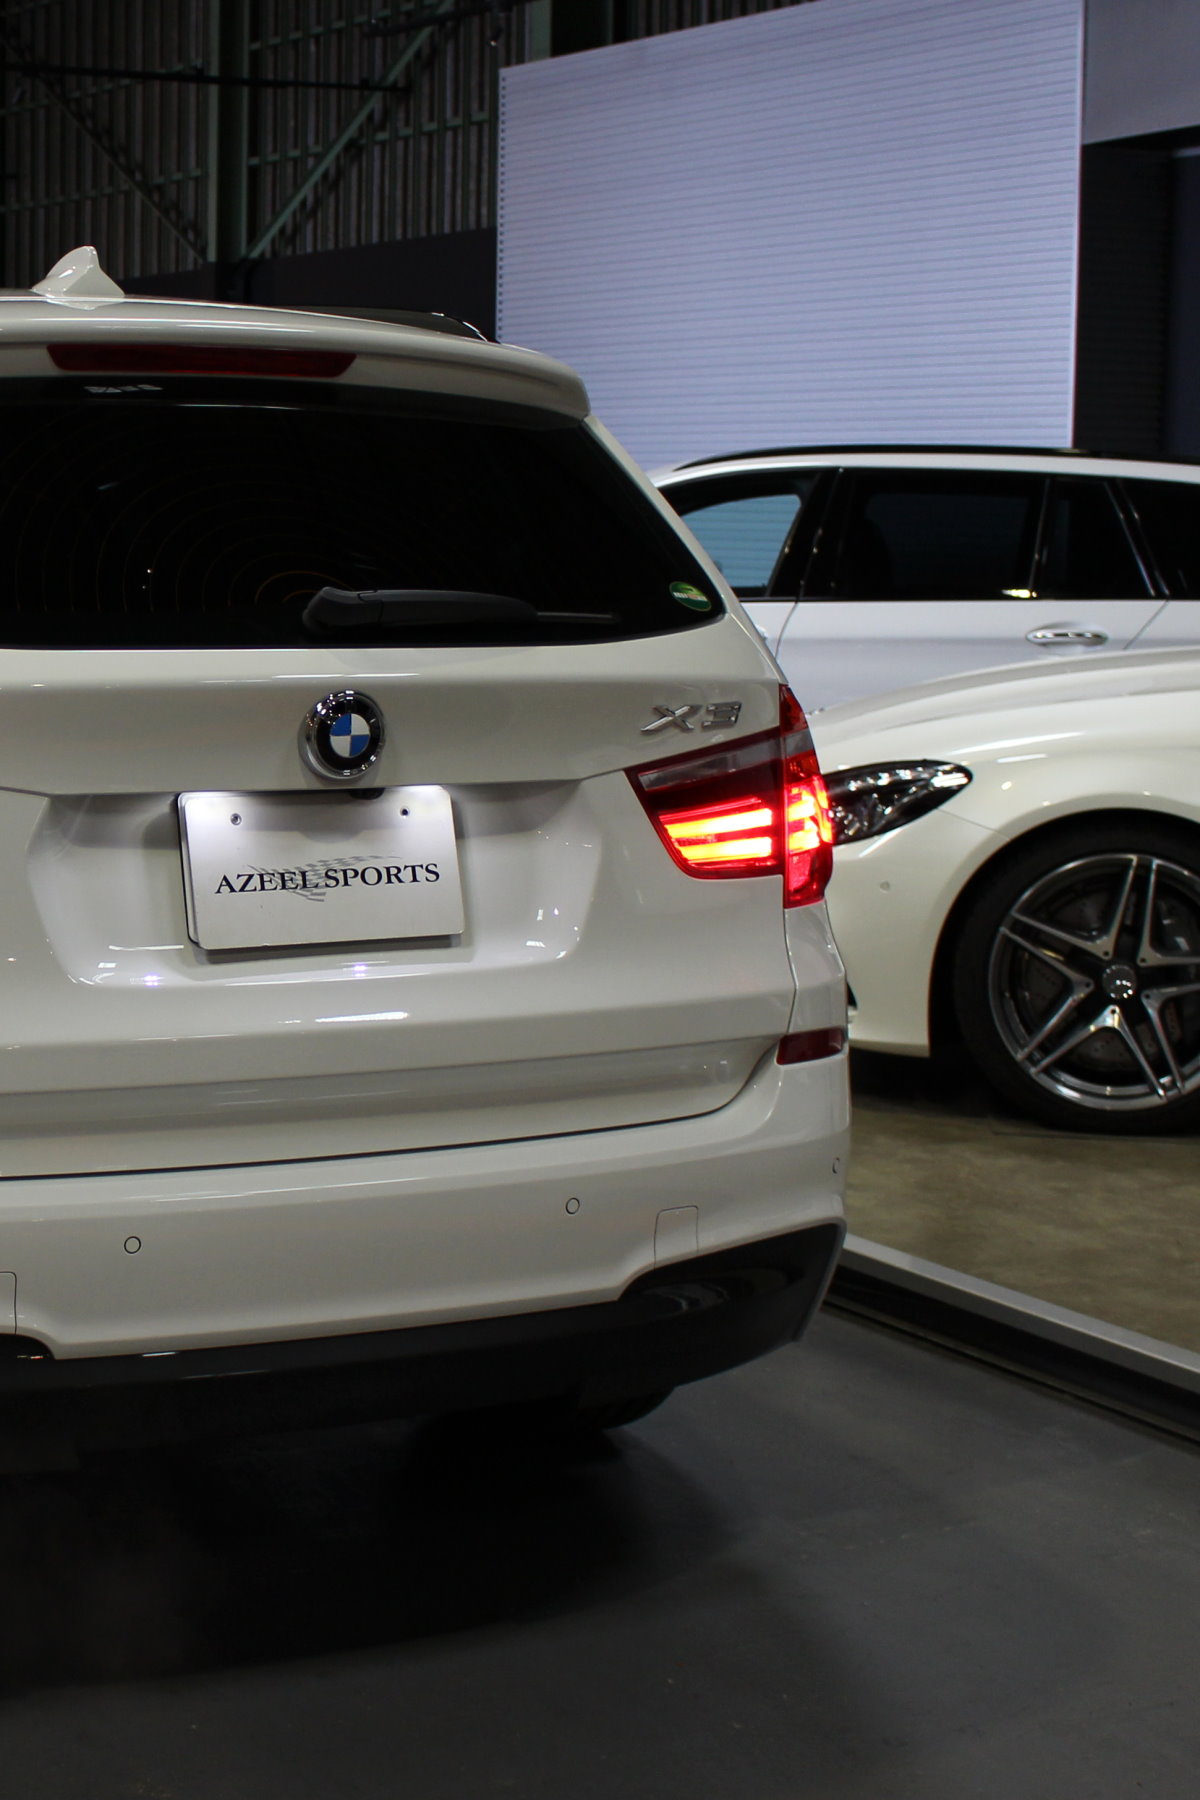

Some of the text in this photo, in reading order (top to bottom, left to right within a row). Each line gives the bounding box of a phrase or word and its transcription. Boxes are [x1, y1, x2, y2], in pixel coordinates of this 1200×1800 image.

[640, 701, 742, 732] X3
[215, 862, 441, 894] AZEEL SPORTS
